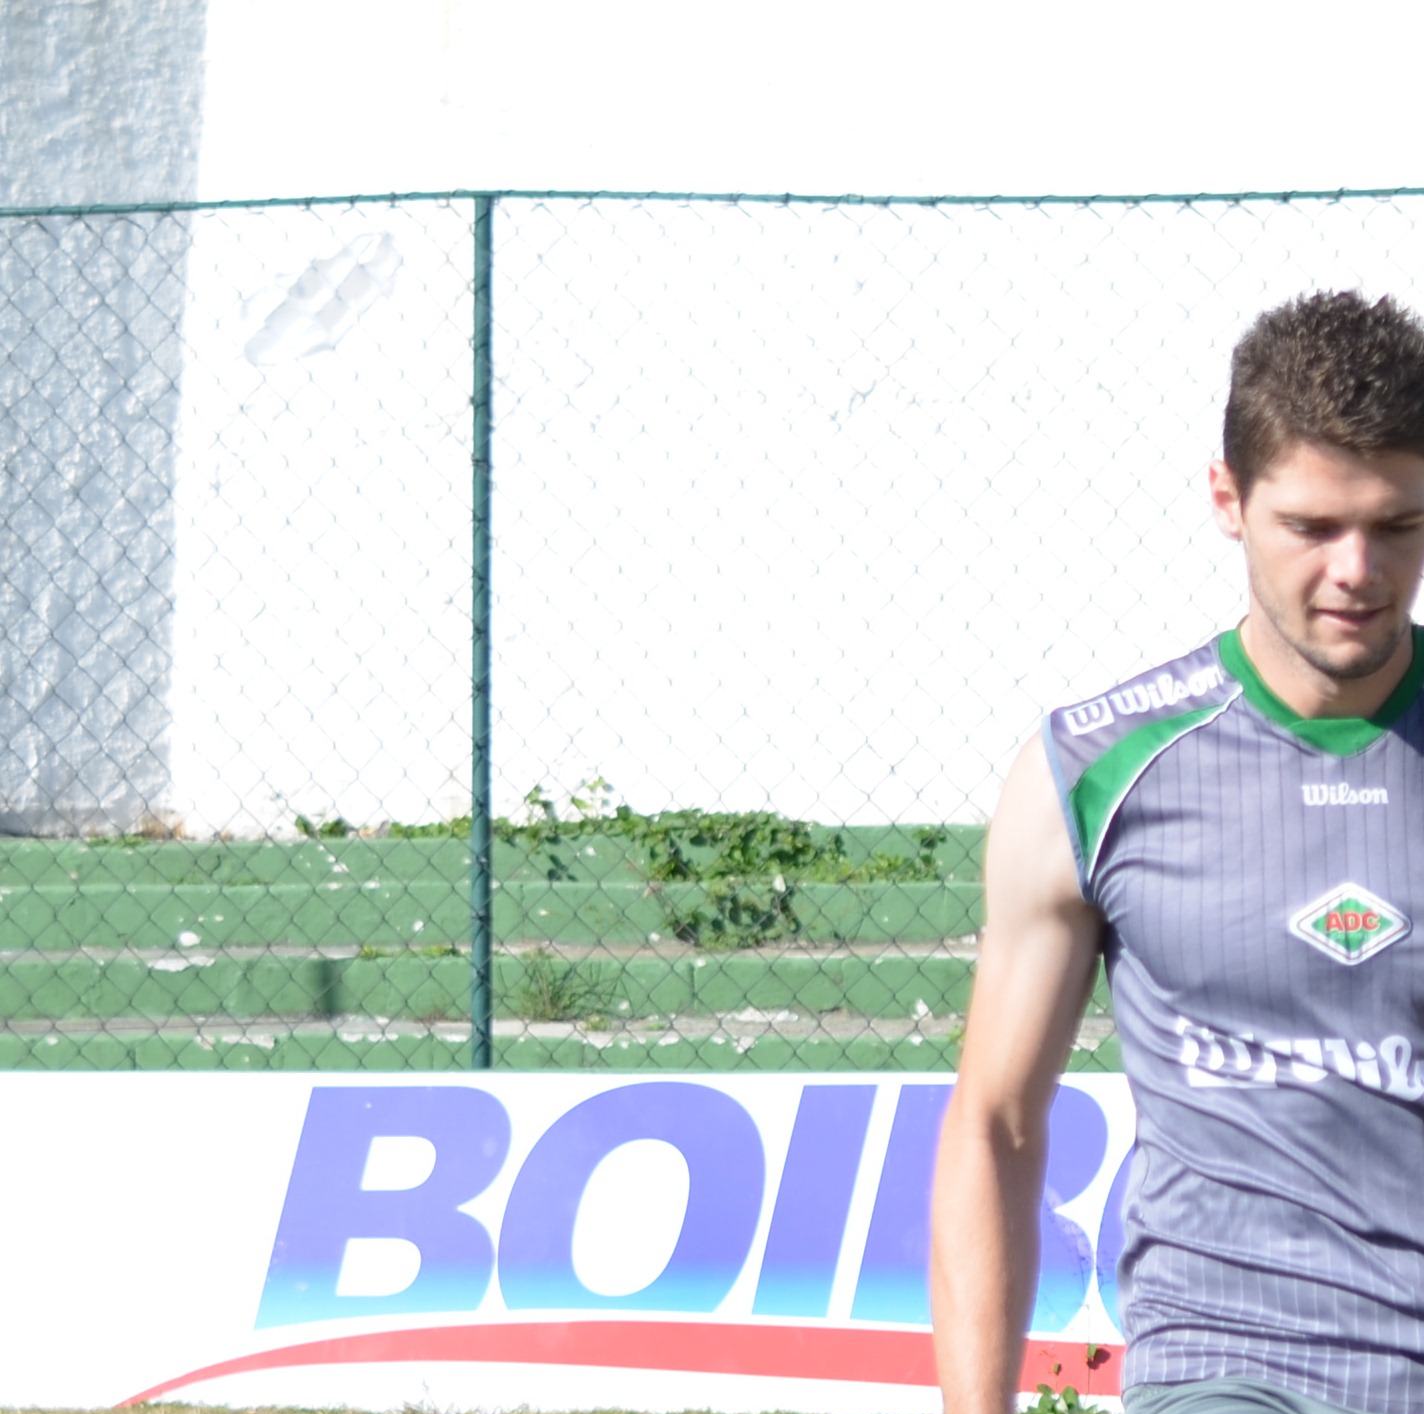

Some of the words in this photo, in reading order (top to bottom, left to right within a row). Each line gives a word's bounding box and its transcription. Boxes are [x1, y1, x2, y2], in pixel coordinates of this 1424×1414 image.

[1108, 664, 1225, 716] Wilson
[1301, 782, 1389, 806] Wilson
[1325, 910, 1380, 933] ADC
